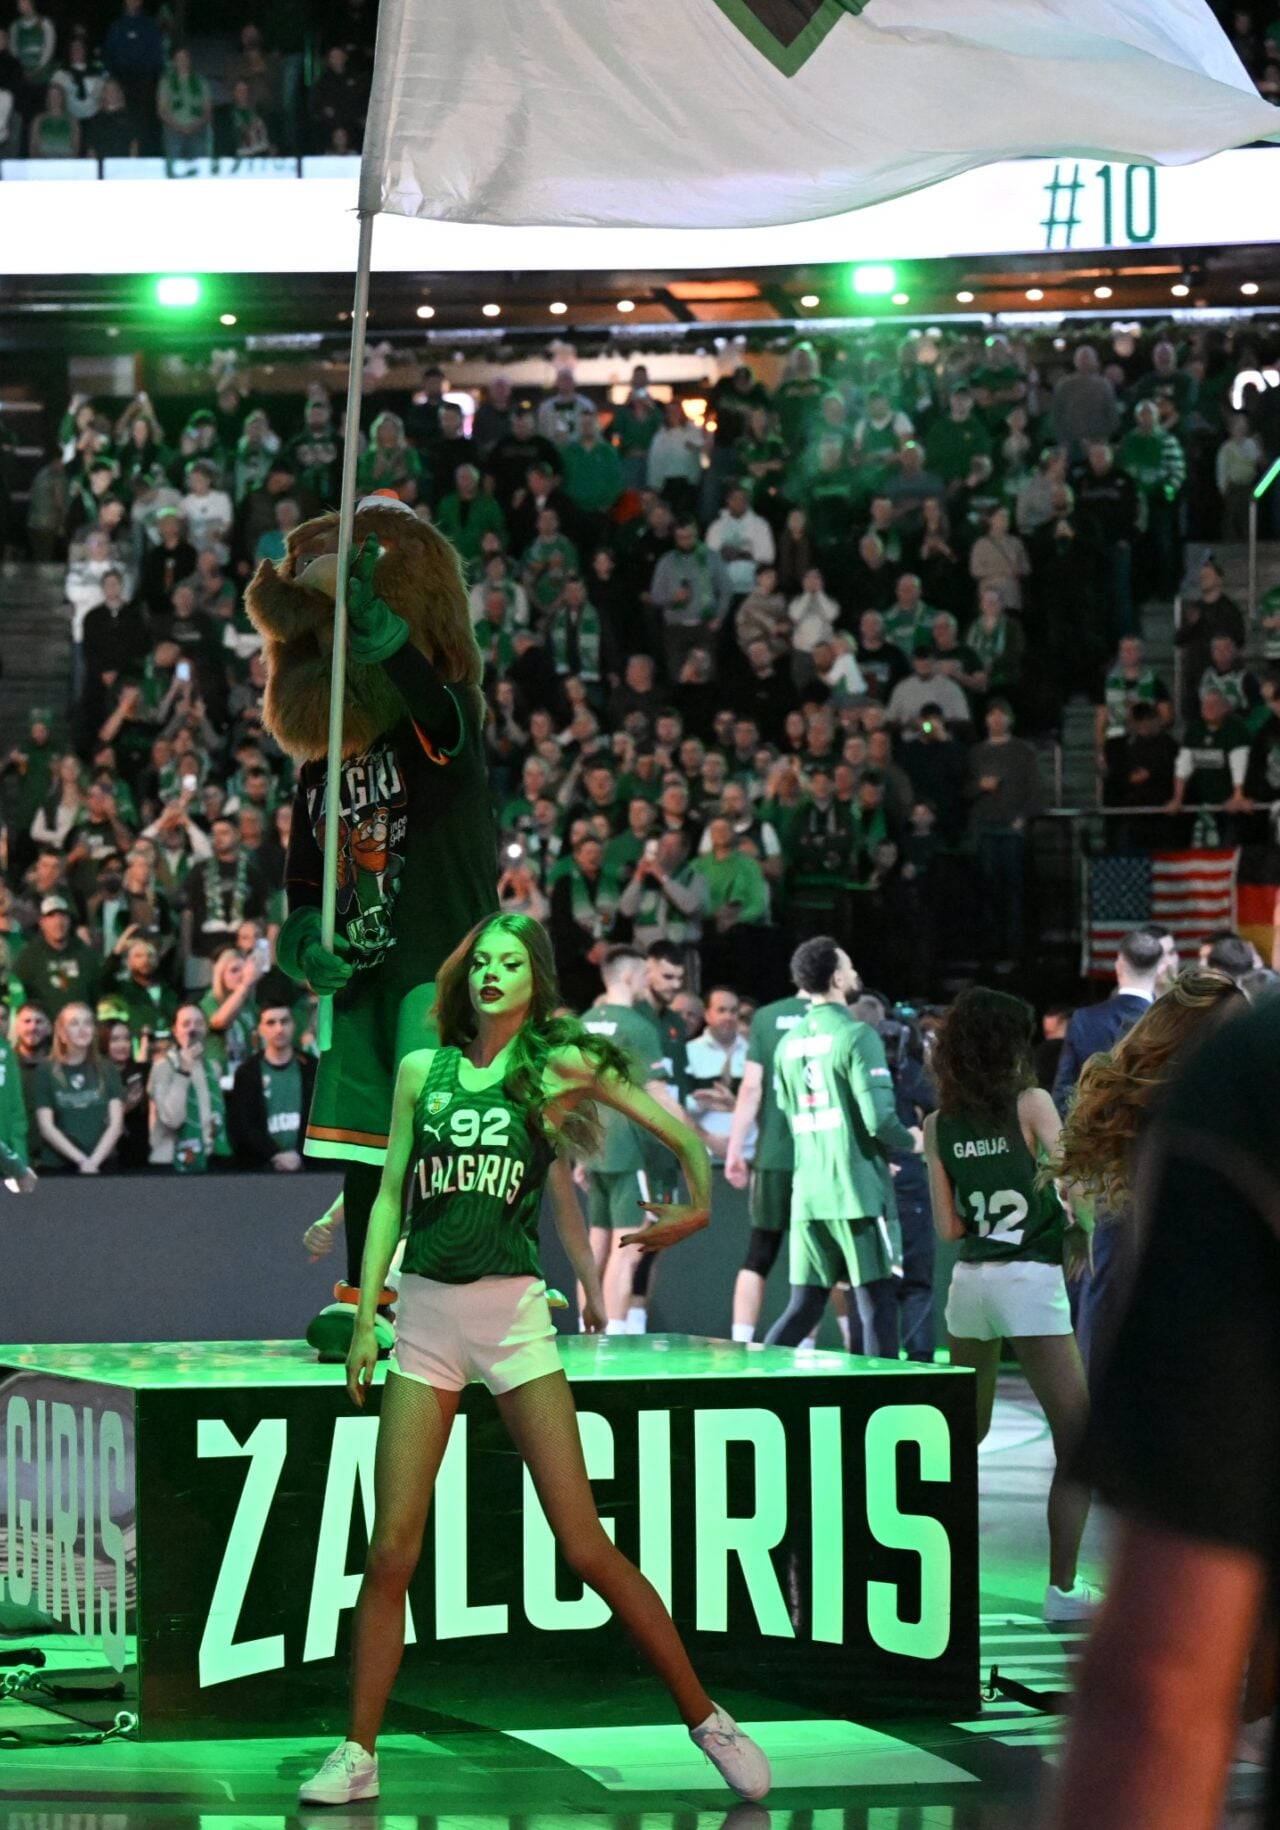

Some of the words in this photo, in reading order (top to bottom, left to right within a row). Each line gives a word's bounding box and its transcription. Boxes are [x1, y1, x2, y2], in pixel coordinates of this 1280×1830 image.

[1040, 164, 1156, 249] #10
[450, 1107, 511, 1147] 92
[953, 1136, 1009, 1158] GABIJA
[968, 1189, 1029, 1245] 12
